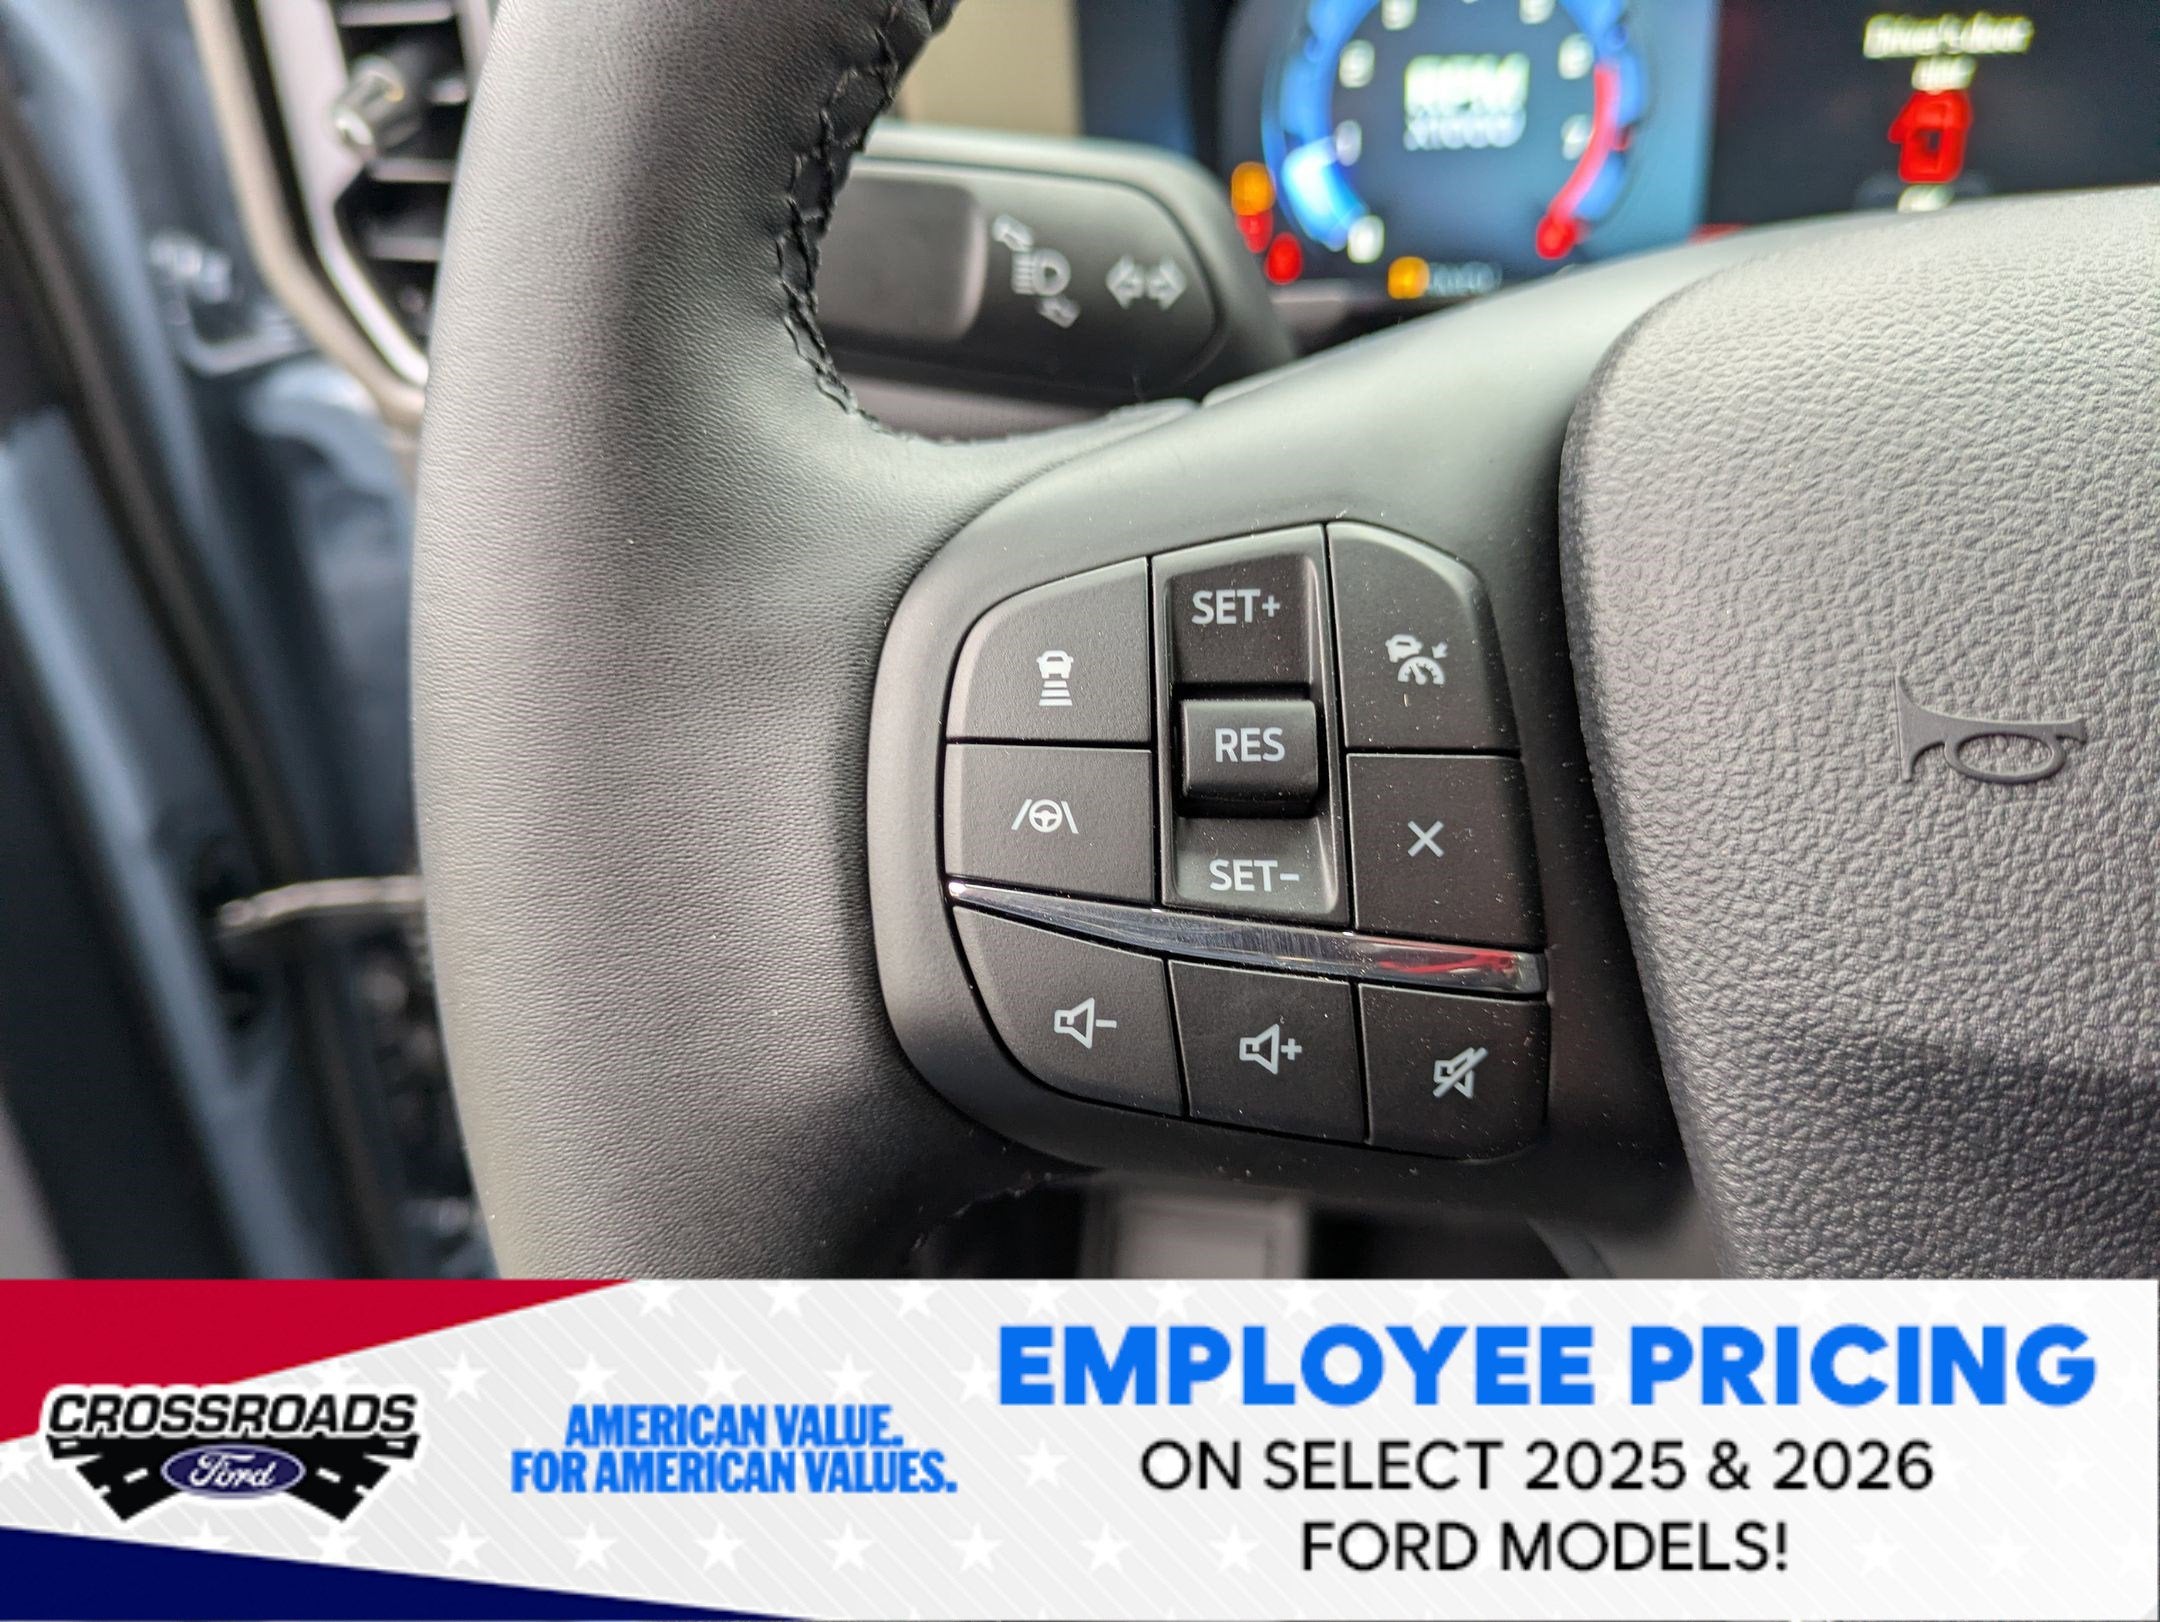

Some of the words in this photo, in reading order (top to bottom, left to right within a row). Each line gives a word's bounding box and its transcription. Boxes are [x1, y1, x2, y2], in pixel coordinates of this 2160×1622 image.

[1191, 589, 1281, 624] SET+
[1215, 727, 1286, 763] RES
[1209, 858, 1300, 892] SET-
